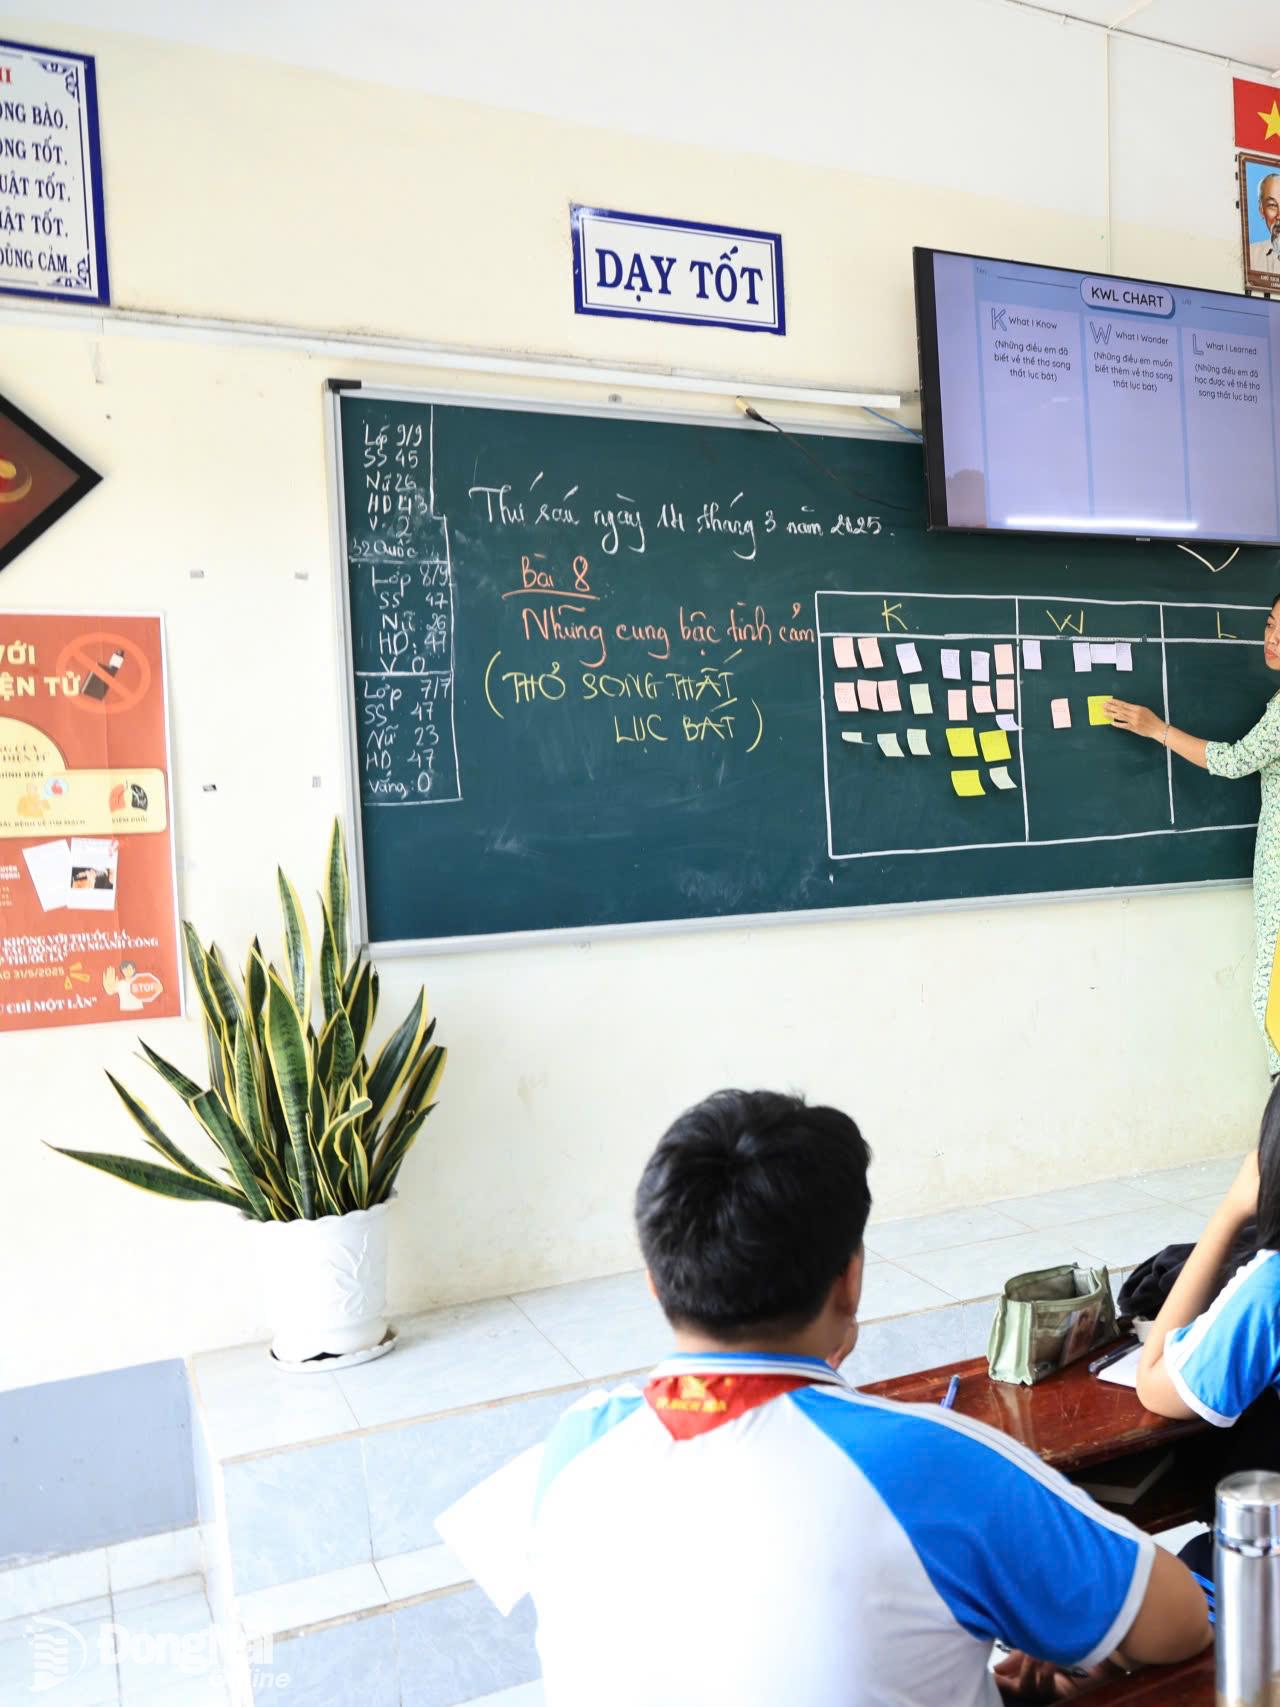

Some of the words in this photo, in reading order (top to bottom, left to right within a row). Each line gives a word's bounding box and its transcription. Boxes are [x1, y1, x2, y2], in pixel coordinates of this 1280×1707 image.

[0, 102, 26, 123] NG
[32, 102, 68, 130] BÀO.
[0, 138, 26, 160] NG
[32, 136, 67, 166] TỐT.
[35, 172, 71, 202] TỐT.
[31, 207, 68, 237] TỐT.
[38, 244, 73, 273] CẢM.
[595, 248, 677, 303] DẠY
[689, 245, 764, 306] TỐT
[1091, 286, 1119, 302] KWL
[1123, 291, 1164, 308] CHART
[991, 307, 1007, 331] K
[1008, 316, 1030, 328] What
[1036, 319, 1058, 330] Know
[1090, 321, 1112, 345] W
[1115, 330, 1135, 341] What
[1141, 335, 1169, 345] Wonder
[1205, 341, 1224, 351] What
[1230, 345, 1257, 355] Learned
[1052, 361, 1071, 371] song
[1156, 372, 1173, 382] song
[396, 423, 422, 447] 9/9
[364, 450, 387, 467] SS
[395, 450, 418, 468] 45
[394, 473, 416, 491] 26
[593, 492, 646, 554] ngày
[697, 492, 757, 560] tháng
[764, 509, 777, 533] 3
[786, 505, 824, 536] năm
[521, 552, 554, 589] Bài
[572, 555, 592, 593] 8
[379, 592, 400, 609] SS
[425, 592, 449, 607] 47
[616, 619, 671, 660] cung
[680, 606, 721, 656] bậc
[779, 602, 815, 643] cảm
[1046, 609, 1085, 635] W
[1216, 611, 1237, 640] L
[424, 631, 447, 653] 47
[44, 671, 81, 697] TỬ
[420, 678, 451, 700] 7/7
[583, 672, 665, 700] SONG
[364, 704, 387, 726] SS
[410, 702, 433, 721] 47
[415, 724, 439, 746] 23
[613, 714, 669, 753] LỤC
[407, 749, 434, 769] 47
[34, 998, 65, 1013] MỘT
